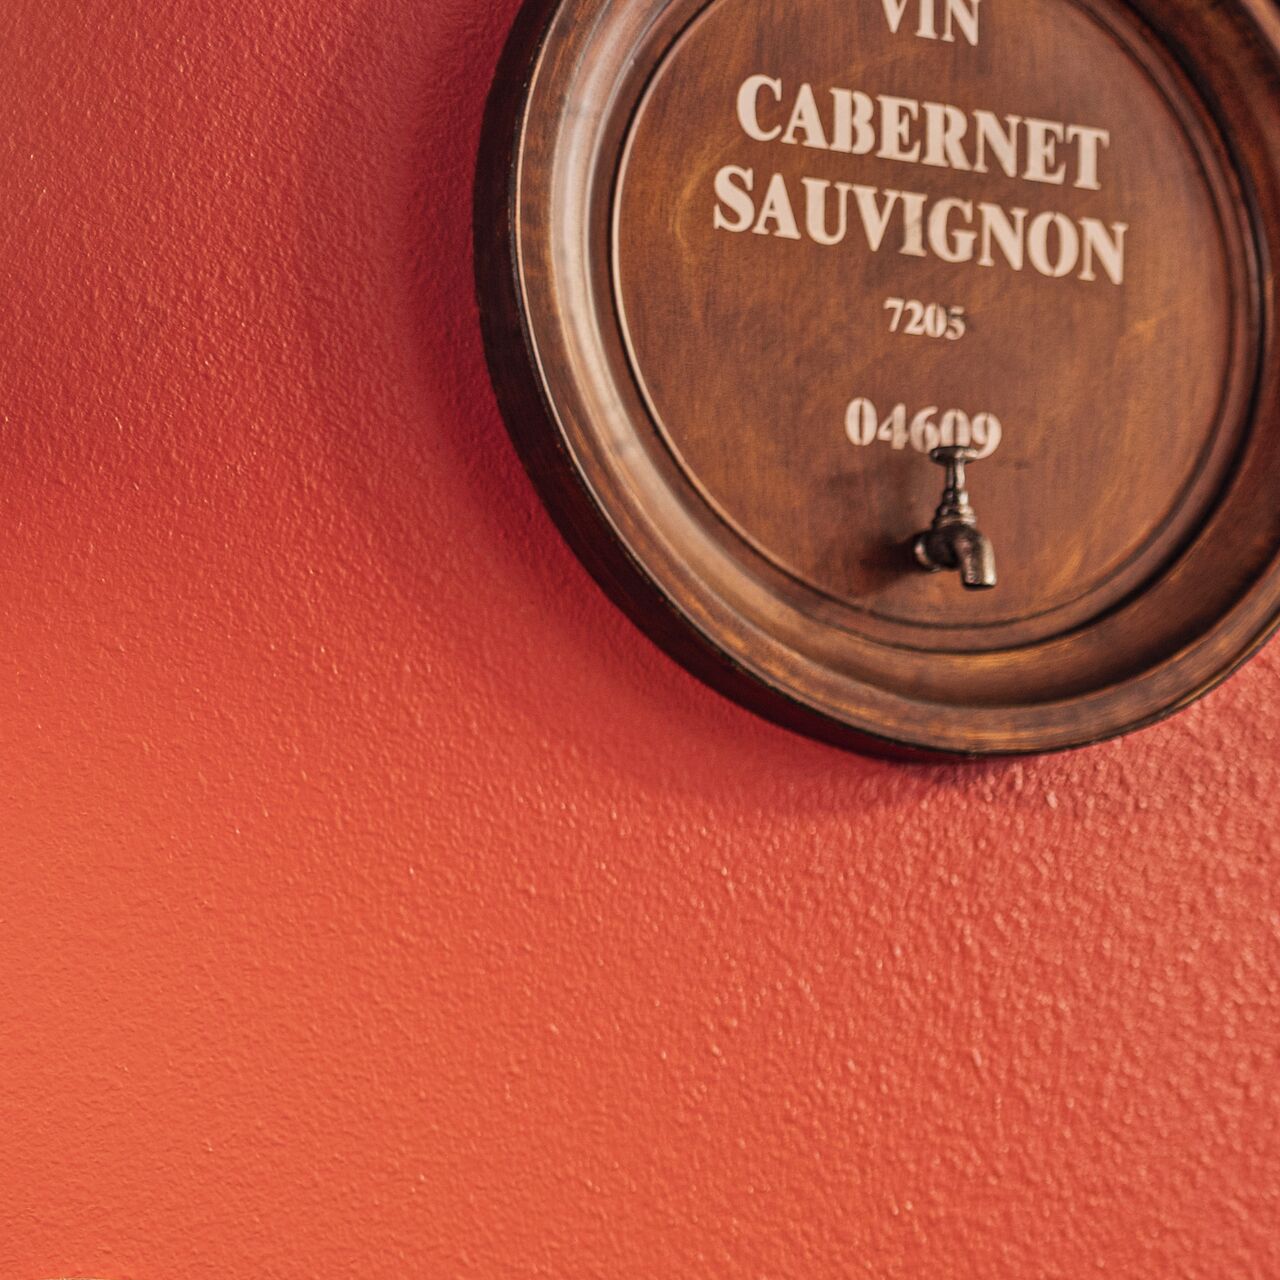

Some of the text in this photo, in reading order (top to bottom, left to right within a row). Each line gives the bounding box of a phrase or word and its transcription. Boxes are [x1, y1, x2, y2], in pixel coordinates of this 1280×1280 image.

[882, 0, 981, 47] VIN
[736, 74, 1110, 191] CABERNET
[713, 165, 1129, 285] SAUVIGNON
[883, 297, 966, 340] 7205
